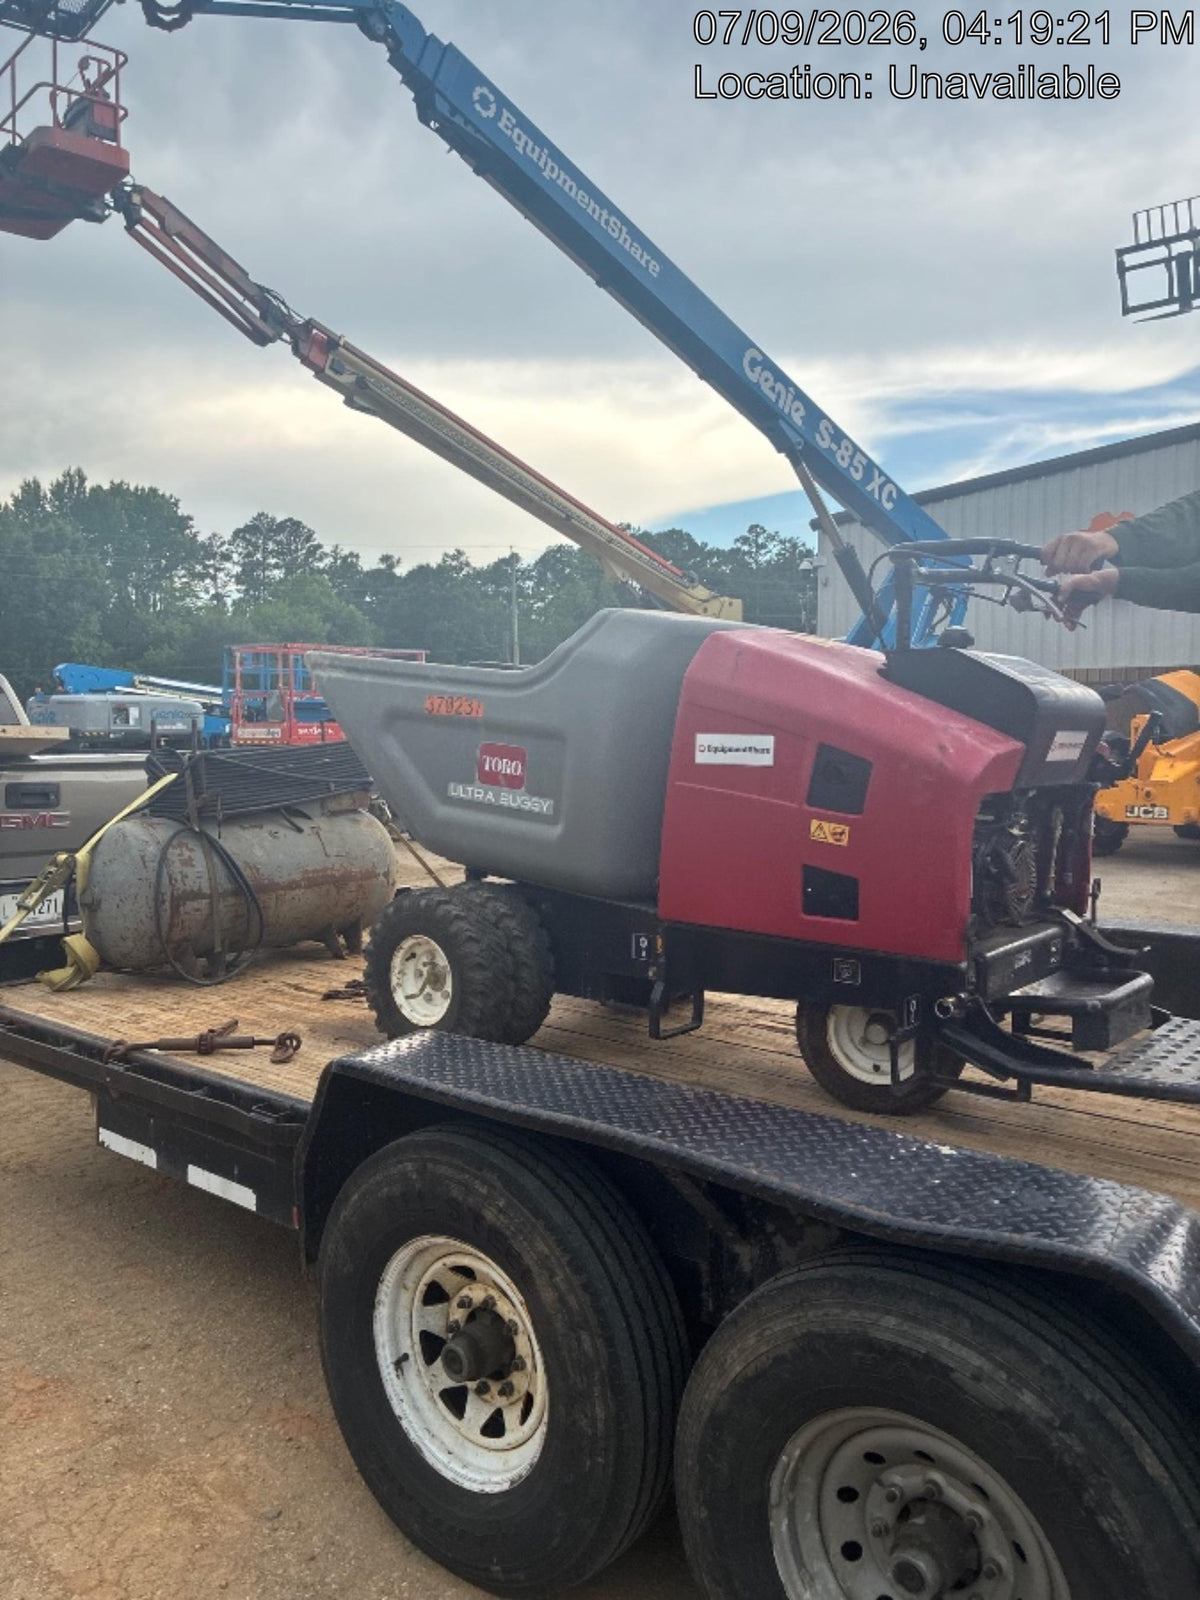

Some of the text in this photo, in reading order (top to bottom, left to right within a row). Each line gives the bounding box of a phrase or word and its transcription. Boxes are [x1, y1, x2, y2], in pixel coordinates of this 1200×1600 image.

[497, 108, 661, 278] EquipmentShare
[743, 348, 806, 427] Genie
[815, 419, 897, 511] S-85 XC
[482, 755, 522, 776] TORO
[450, 783, 551, 813] ULTRA BUGGY
[1126, 805, 1168, 819] JCB
[0, 811, 70, 829] GMC
